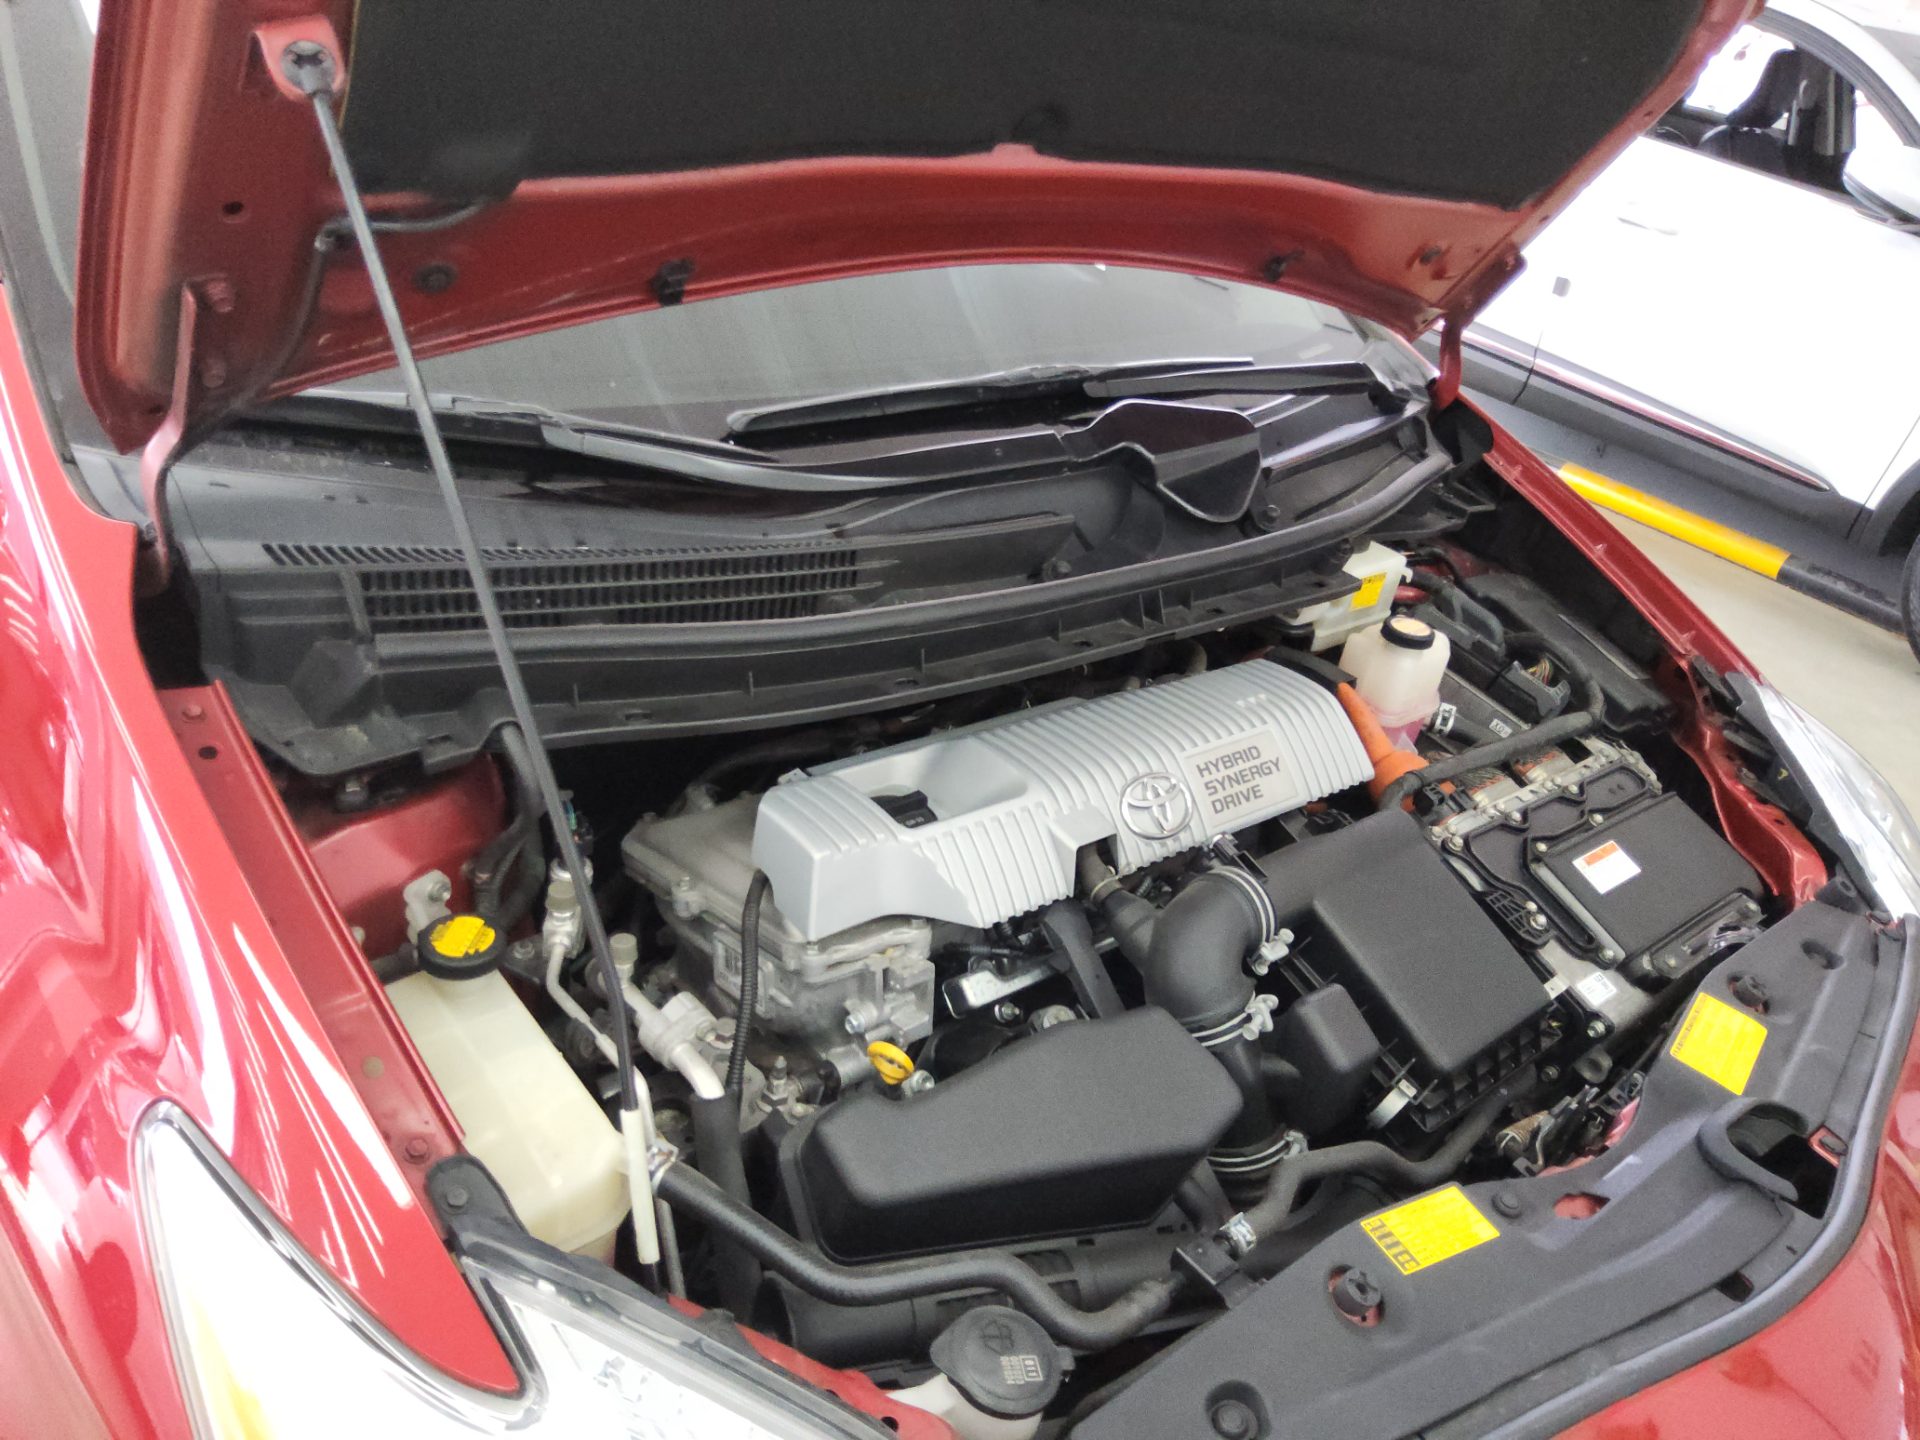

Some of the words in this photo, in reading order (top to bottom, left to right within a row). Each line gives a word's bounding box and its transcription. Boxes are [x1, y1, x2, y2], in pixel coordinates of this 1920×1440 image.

[1196, 745, 1261, 778] HYBRID
[1204, 757, 1281, 796] SYNERGY
[1211, 784, 1264, 814] DRIVE
